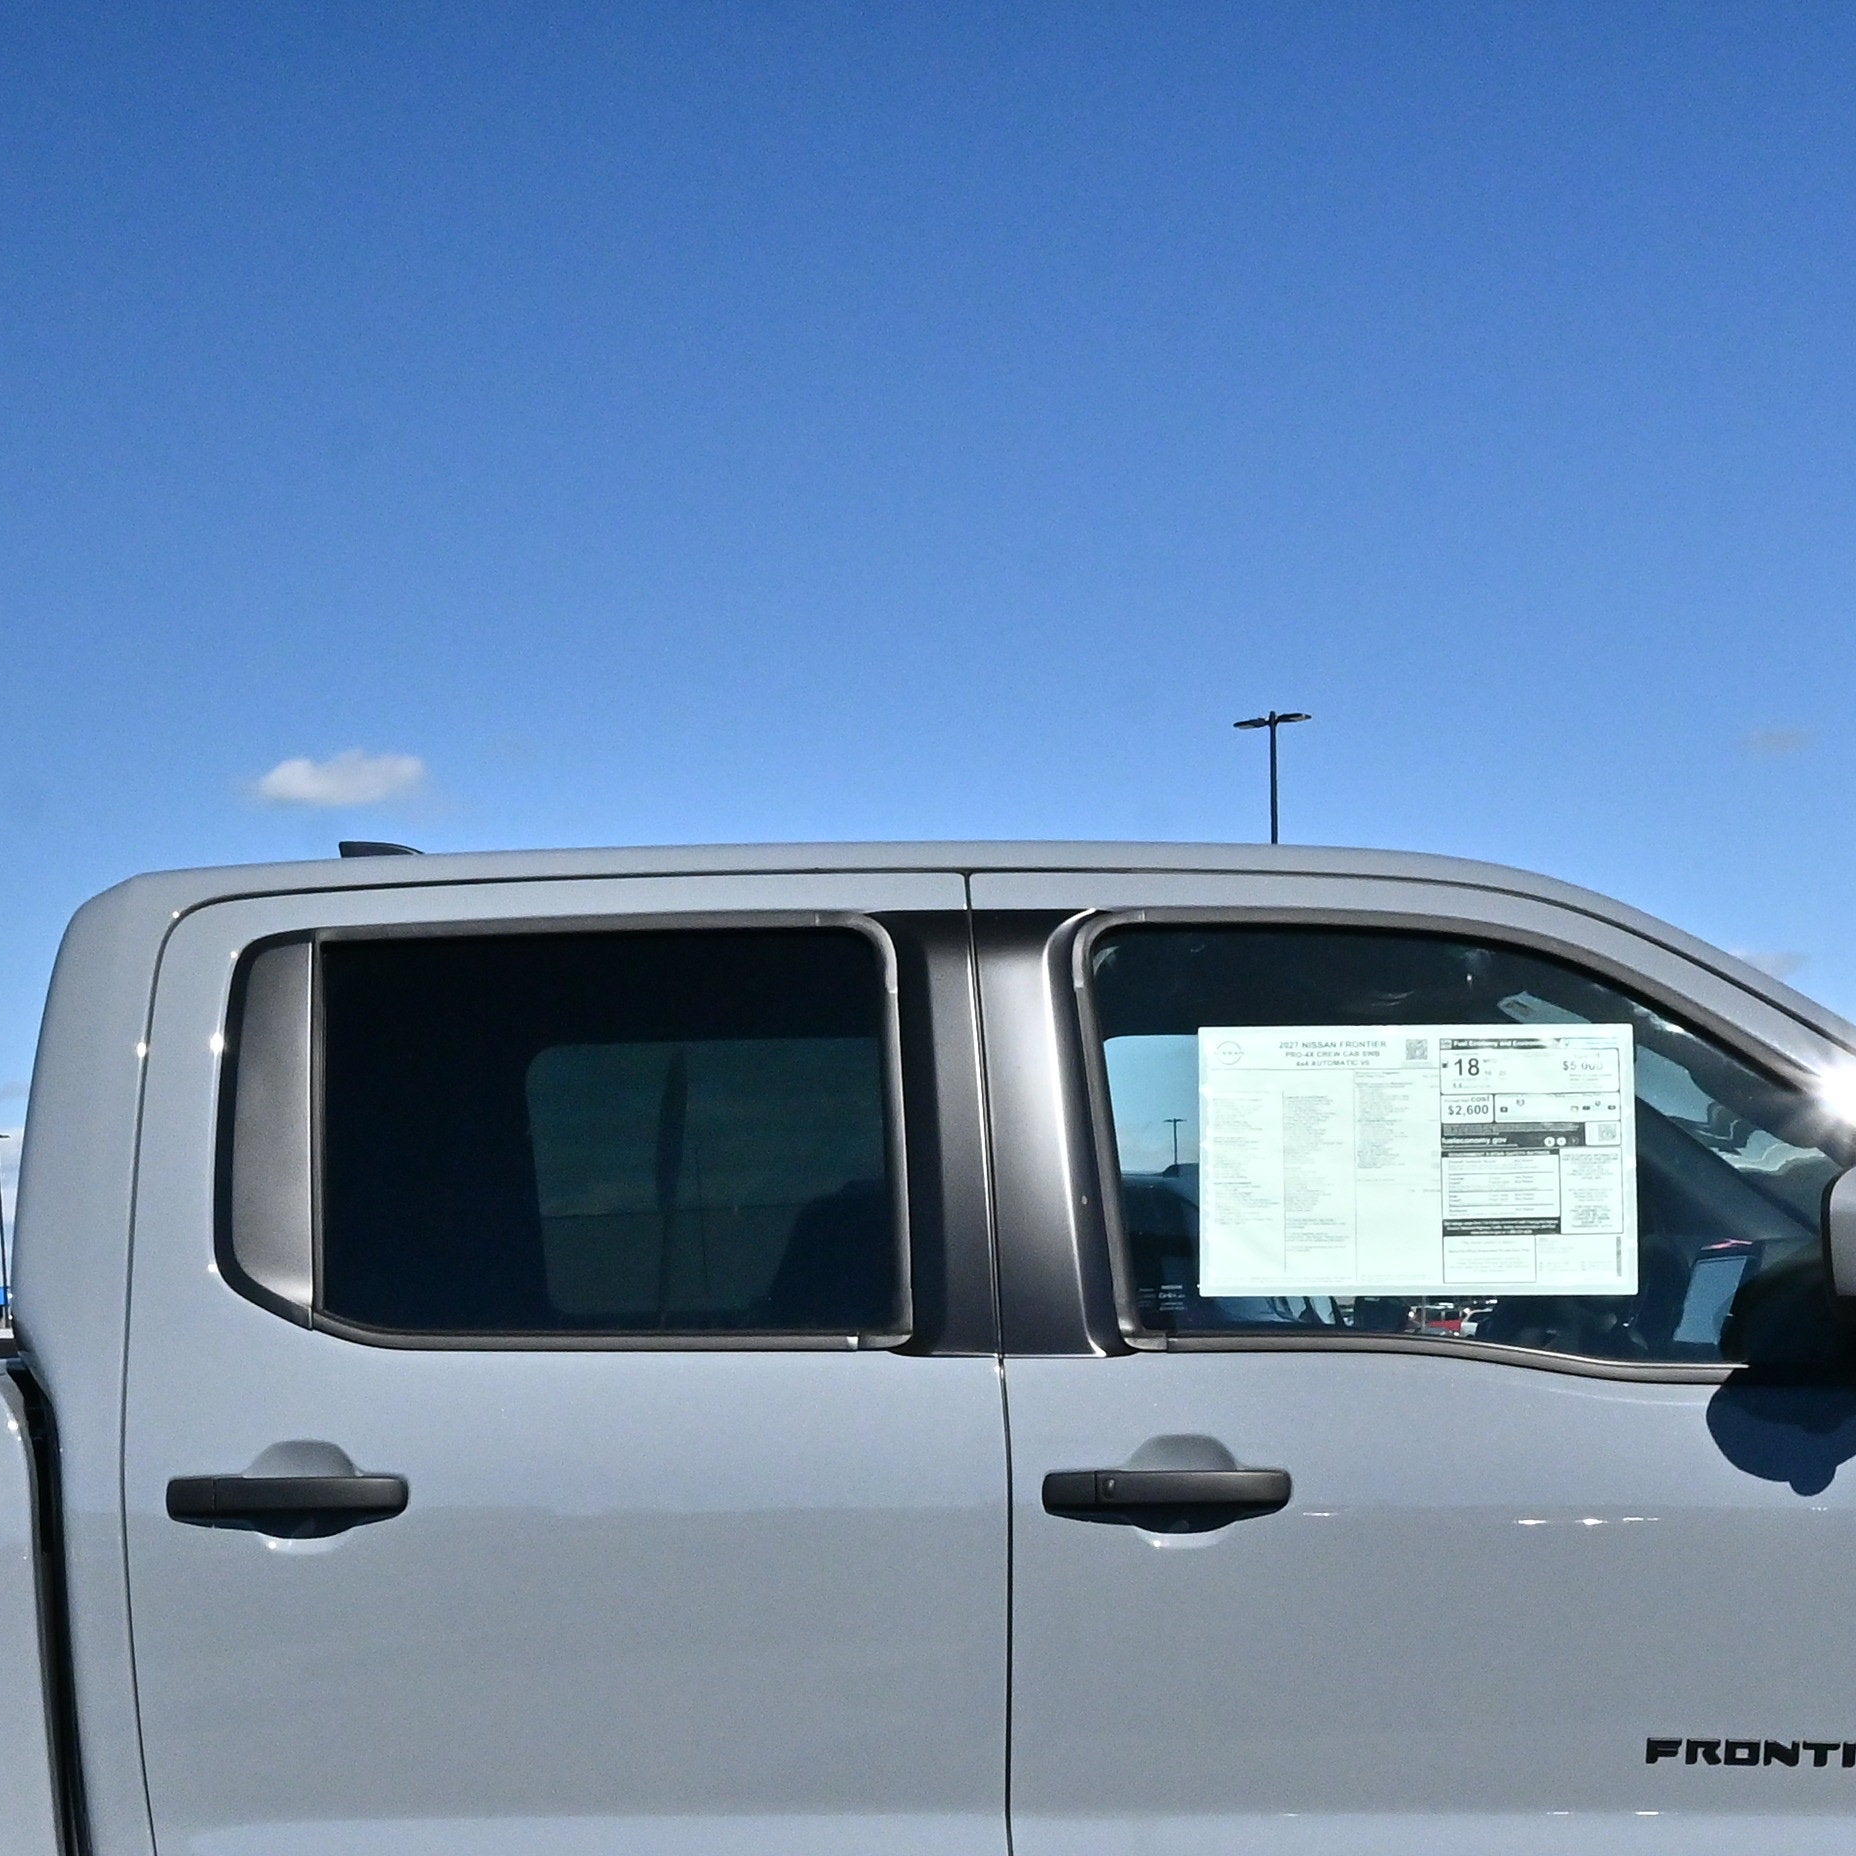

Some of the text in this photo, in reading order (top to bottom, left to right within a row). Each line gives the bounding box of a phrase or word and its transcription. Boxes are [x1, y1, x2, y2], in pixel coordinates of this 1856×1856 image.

[1302, 1041, 1337, 1049] NISSAN
[1339, 1040, 1387, 1048] FRONTIER
[1454, 1057, 1480, 1077] 18
[1447, 1104, 1489, 1117] $2,600
